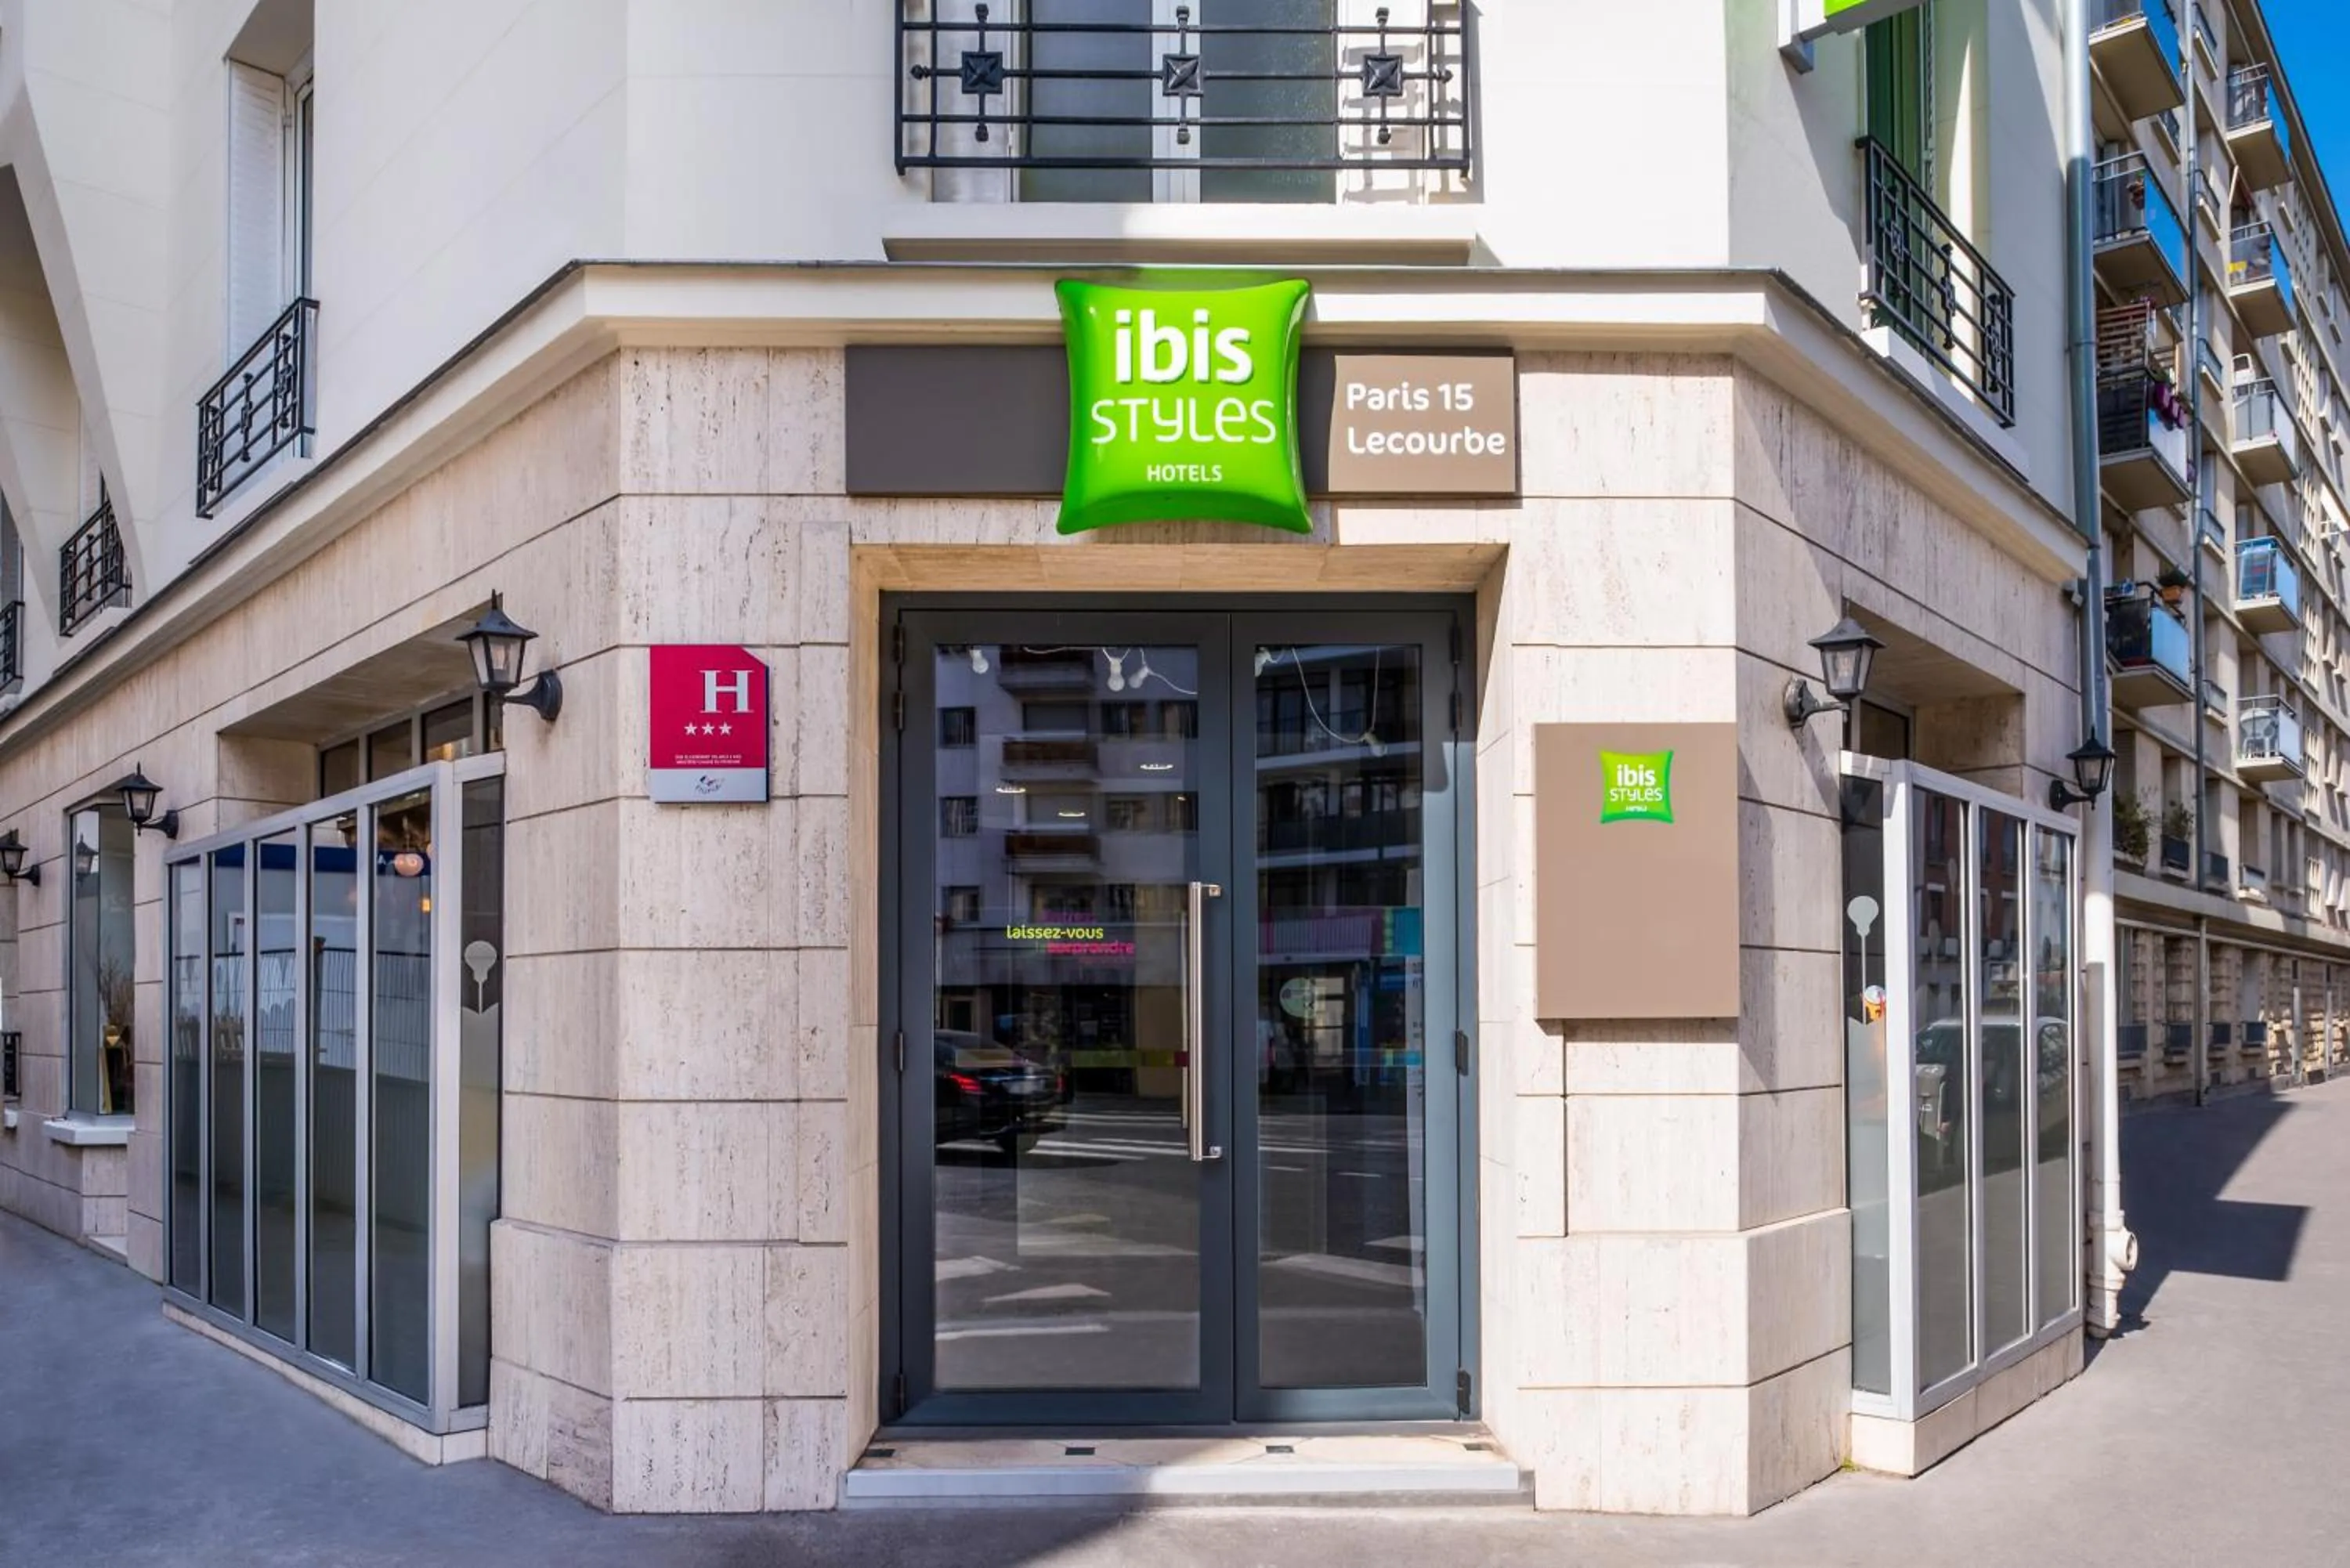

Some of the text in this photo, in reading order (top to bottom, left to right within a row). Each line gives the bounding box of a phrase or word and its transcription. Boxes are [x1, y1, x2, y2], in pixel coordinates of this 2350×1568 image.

[1115, 309, 1253, 384] ibis
[1347, 381, 1473, 411] Paris 15
[1347, 426, 1506, 454] Lecourbe
[1147, 464, 1223, 482] HOTELS
[700, 670, 754, 714] H
[1617, 764, 1656, 786] ibis
[1006, 924, 1104, 939] laissez-vous
